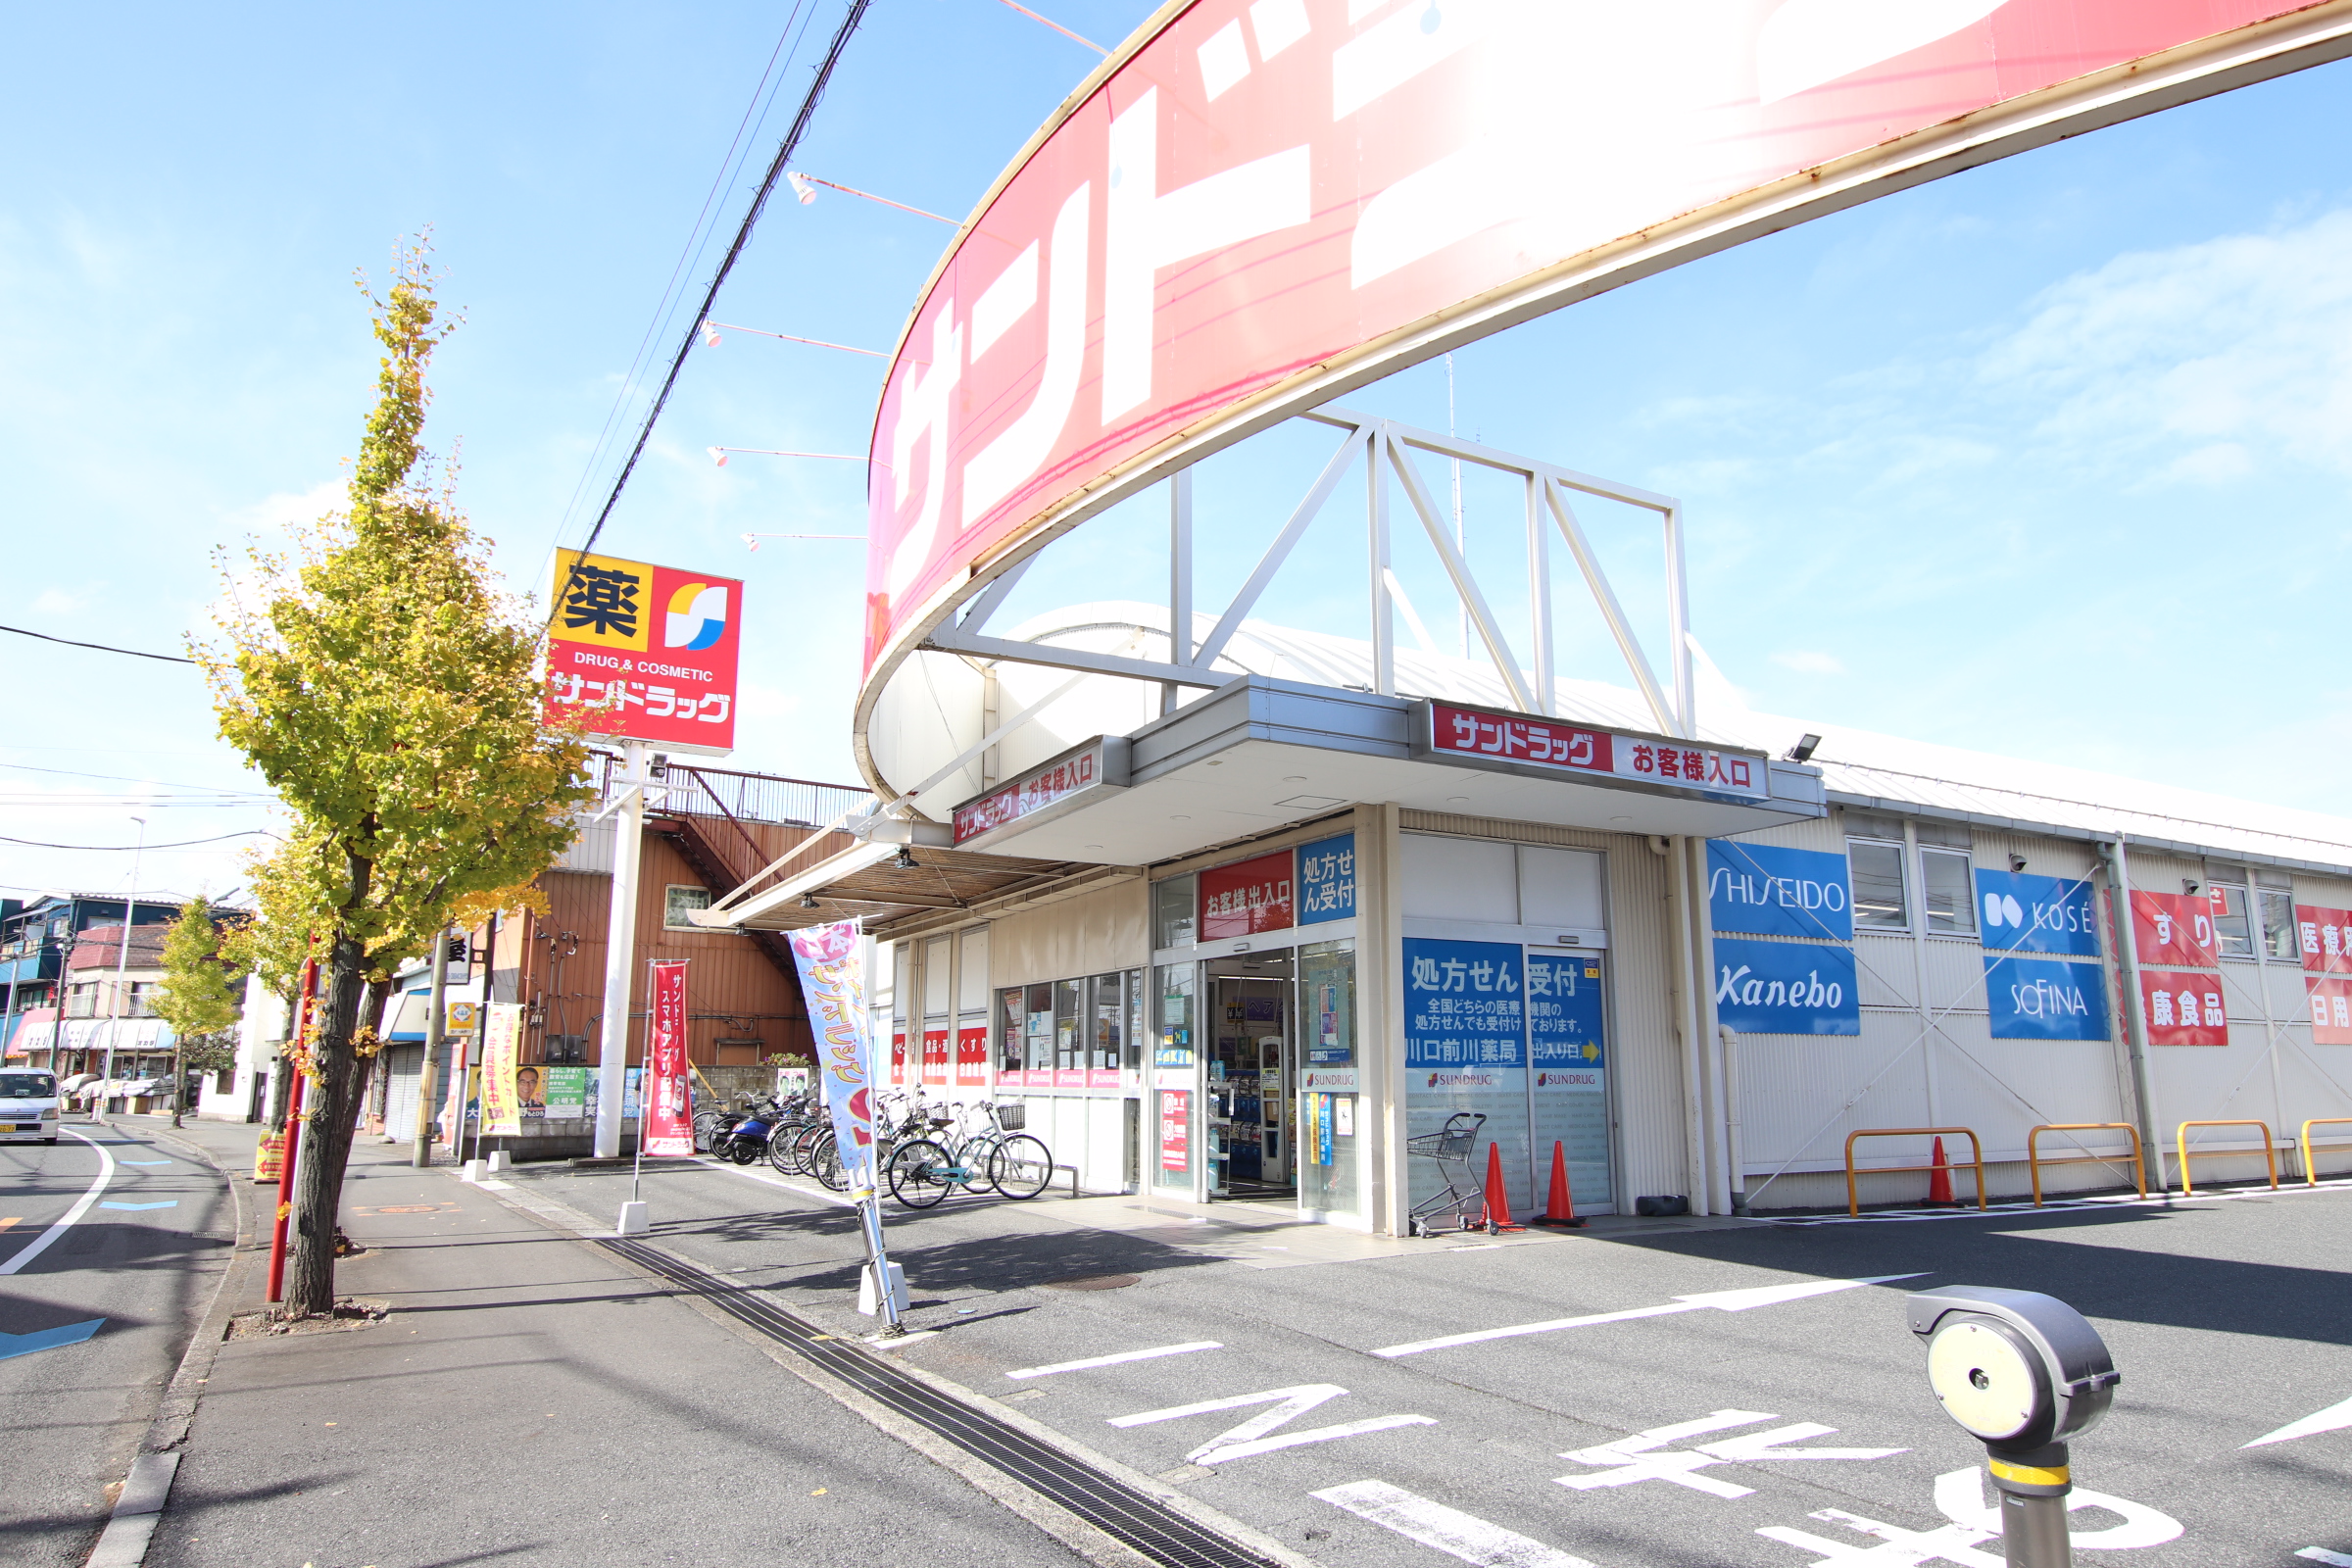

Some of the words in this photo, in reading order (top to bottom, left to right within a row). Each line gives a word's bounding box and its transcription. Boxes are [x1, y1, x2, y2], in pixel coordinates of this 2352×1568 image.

[564, 565, 640, 638] 薬
[574, 652, 619, 669] DRUG
[622, 659, 633, 671] &
[637, 661, 713, 682] COSMETIC
[552, 671, 731, 724] サンドラッグ
[1452, 713, 1595, 766] サンドラッグ
[1633, 745, 1751, 787] お客様入口
[960, 791, 1012, 839] サンドラッグ
[1028, 753, 1093, 806] お客様入口
[1303, 849, 1354, 884] 処方せ
[1206, 879, 1291, 918] お客様出入口
[1304, 879, 1355, 912] ん受付
[1709, 867, 1844, 912] SHISEIDO
[2033, 902, 2092, 933] KOSÉ
[1716, 964, 1842, 1008] Kanebo
[2011, 979, 2088, 1018] SOFINA
[672, 974, 682, 1062] サンドグ
[2142, 989, 2224, 1027] 康食品
[659, 990, 671, 1121] スマホアプリ配信中
[1405, 1038, 1517, 1062] 川口前川薬局
[624, 1068, 637, 1117] 幸福実現党
[1315, 1074, 1353, 1086] SUNDRUG
[1440, 1074, 1493, 1086] SUNDRUG
[1547, 1074, 1595, 1085] SUNDRUG
